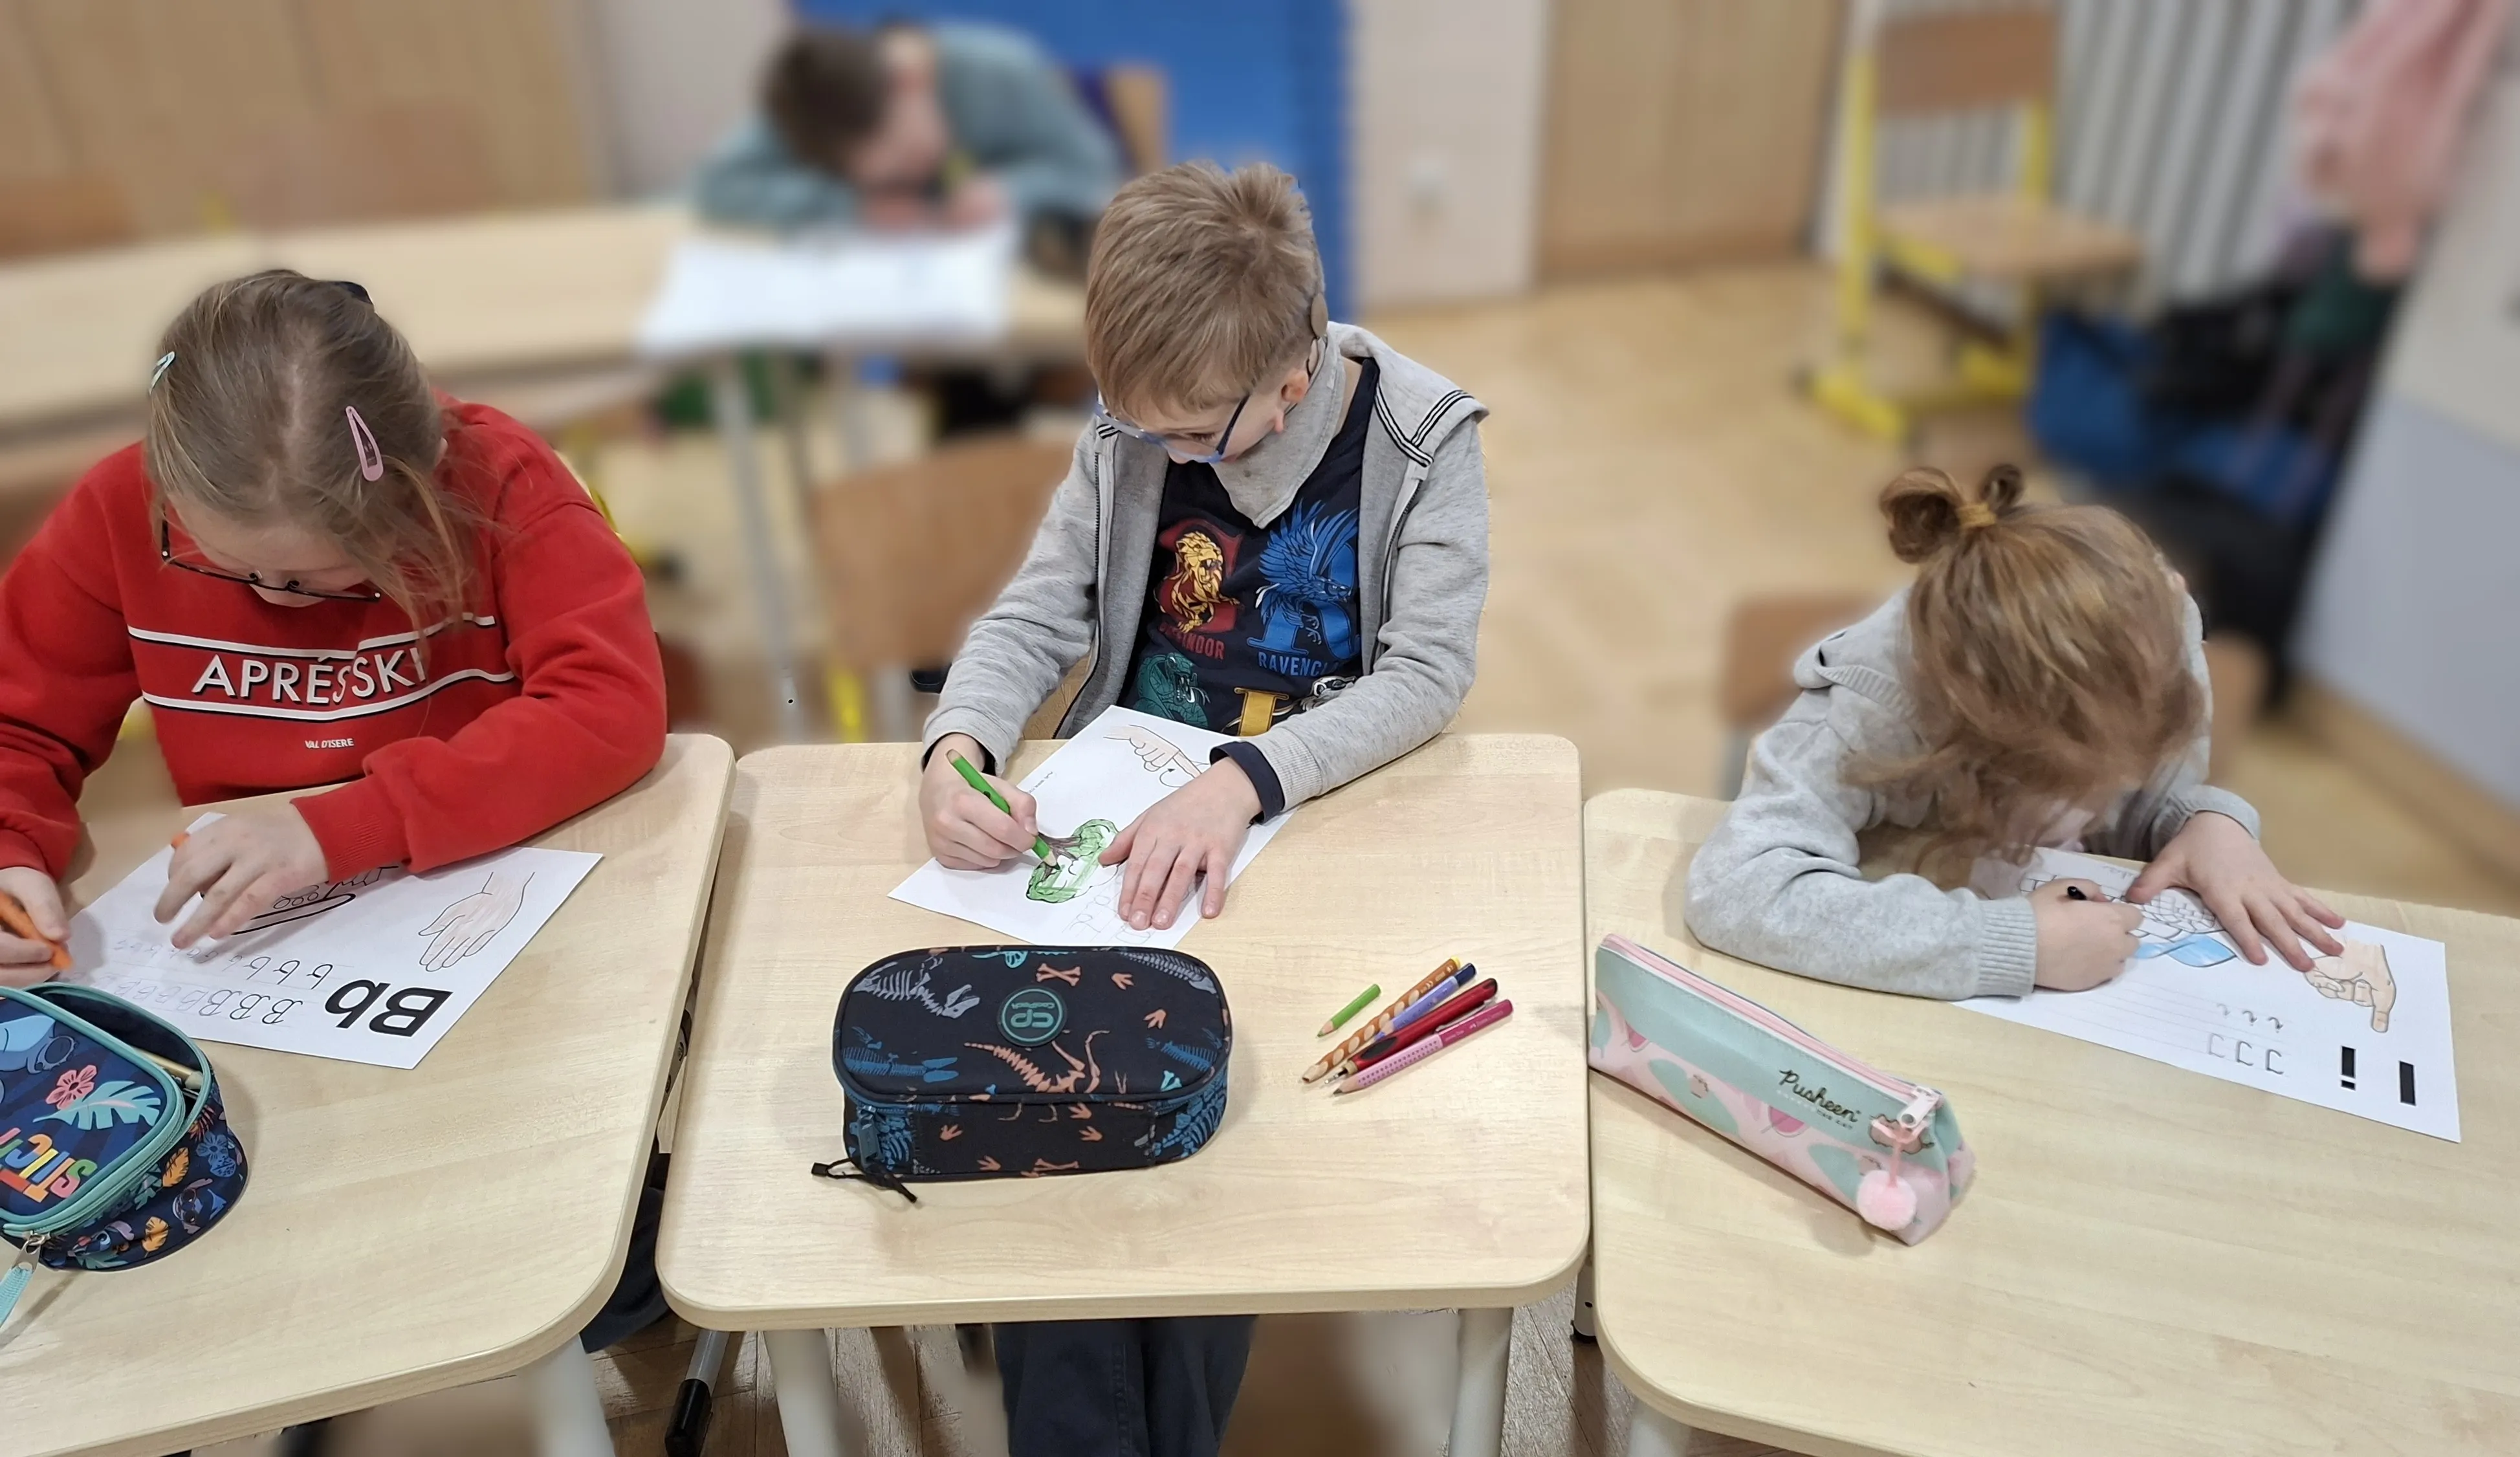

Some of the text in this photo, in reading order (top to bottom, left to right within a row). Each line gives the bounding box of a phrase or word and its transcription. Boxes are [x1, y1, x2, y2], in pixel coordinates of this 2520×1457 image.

[351, 647, 426, 698] SKI
[305, 740, 320, 749] VAL
[1779, 1069, 1858, 1123] Pusheen
